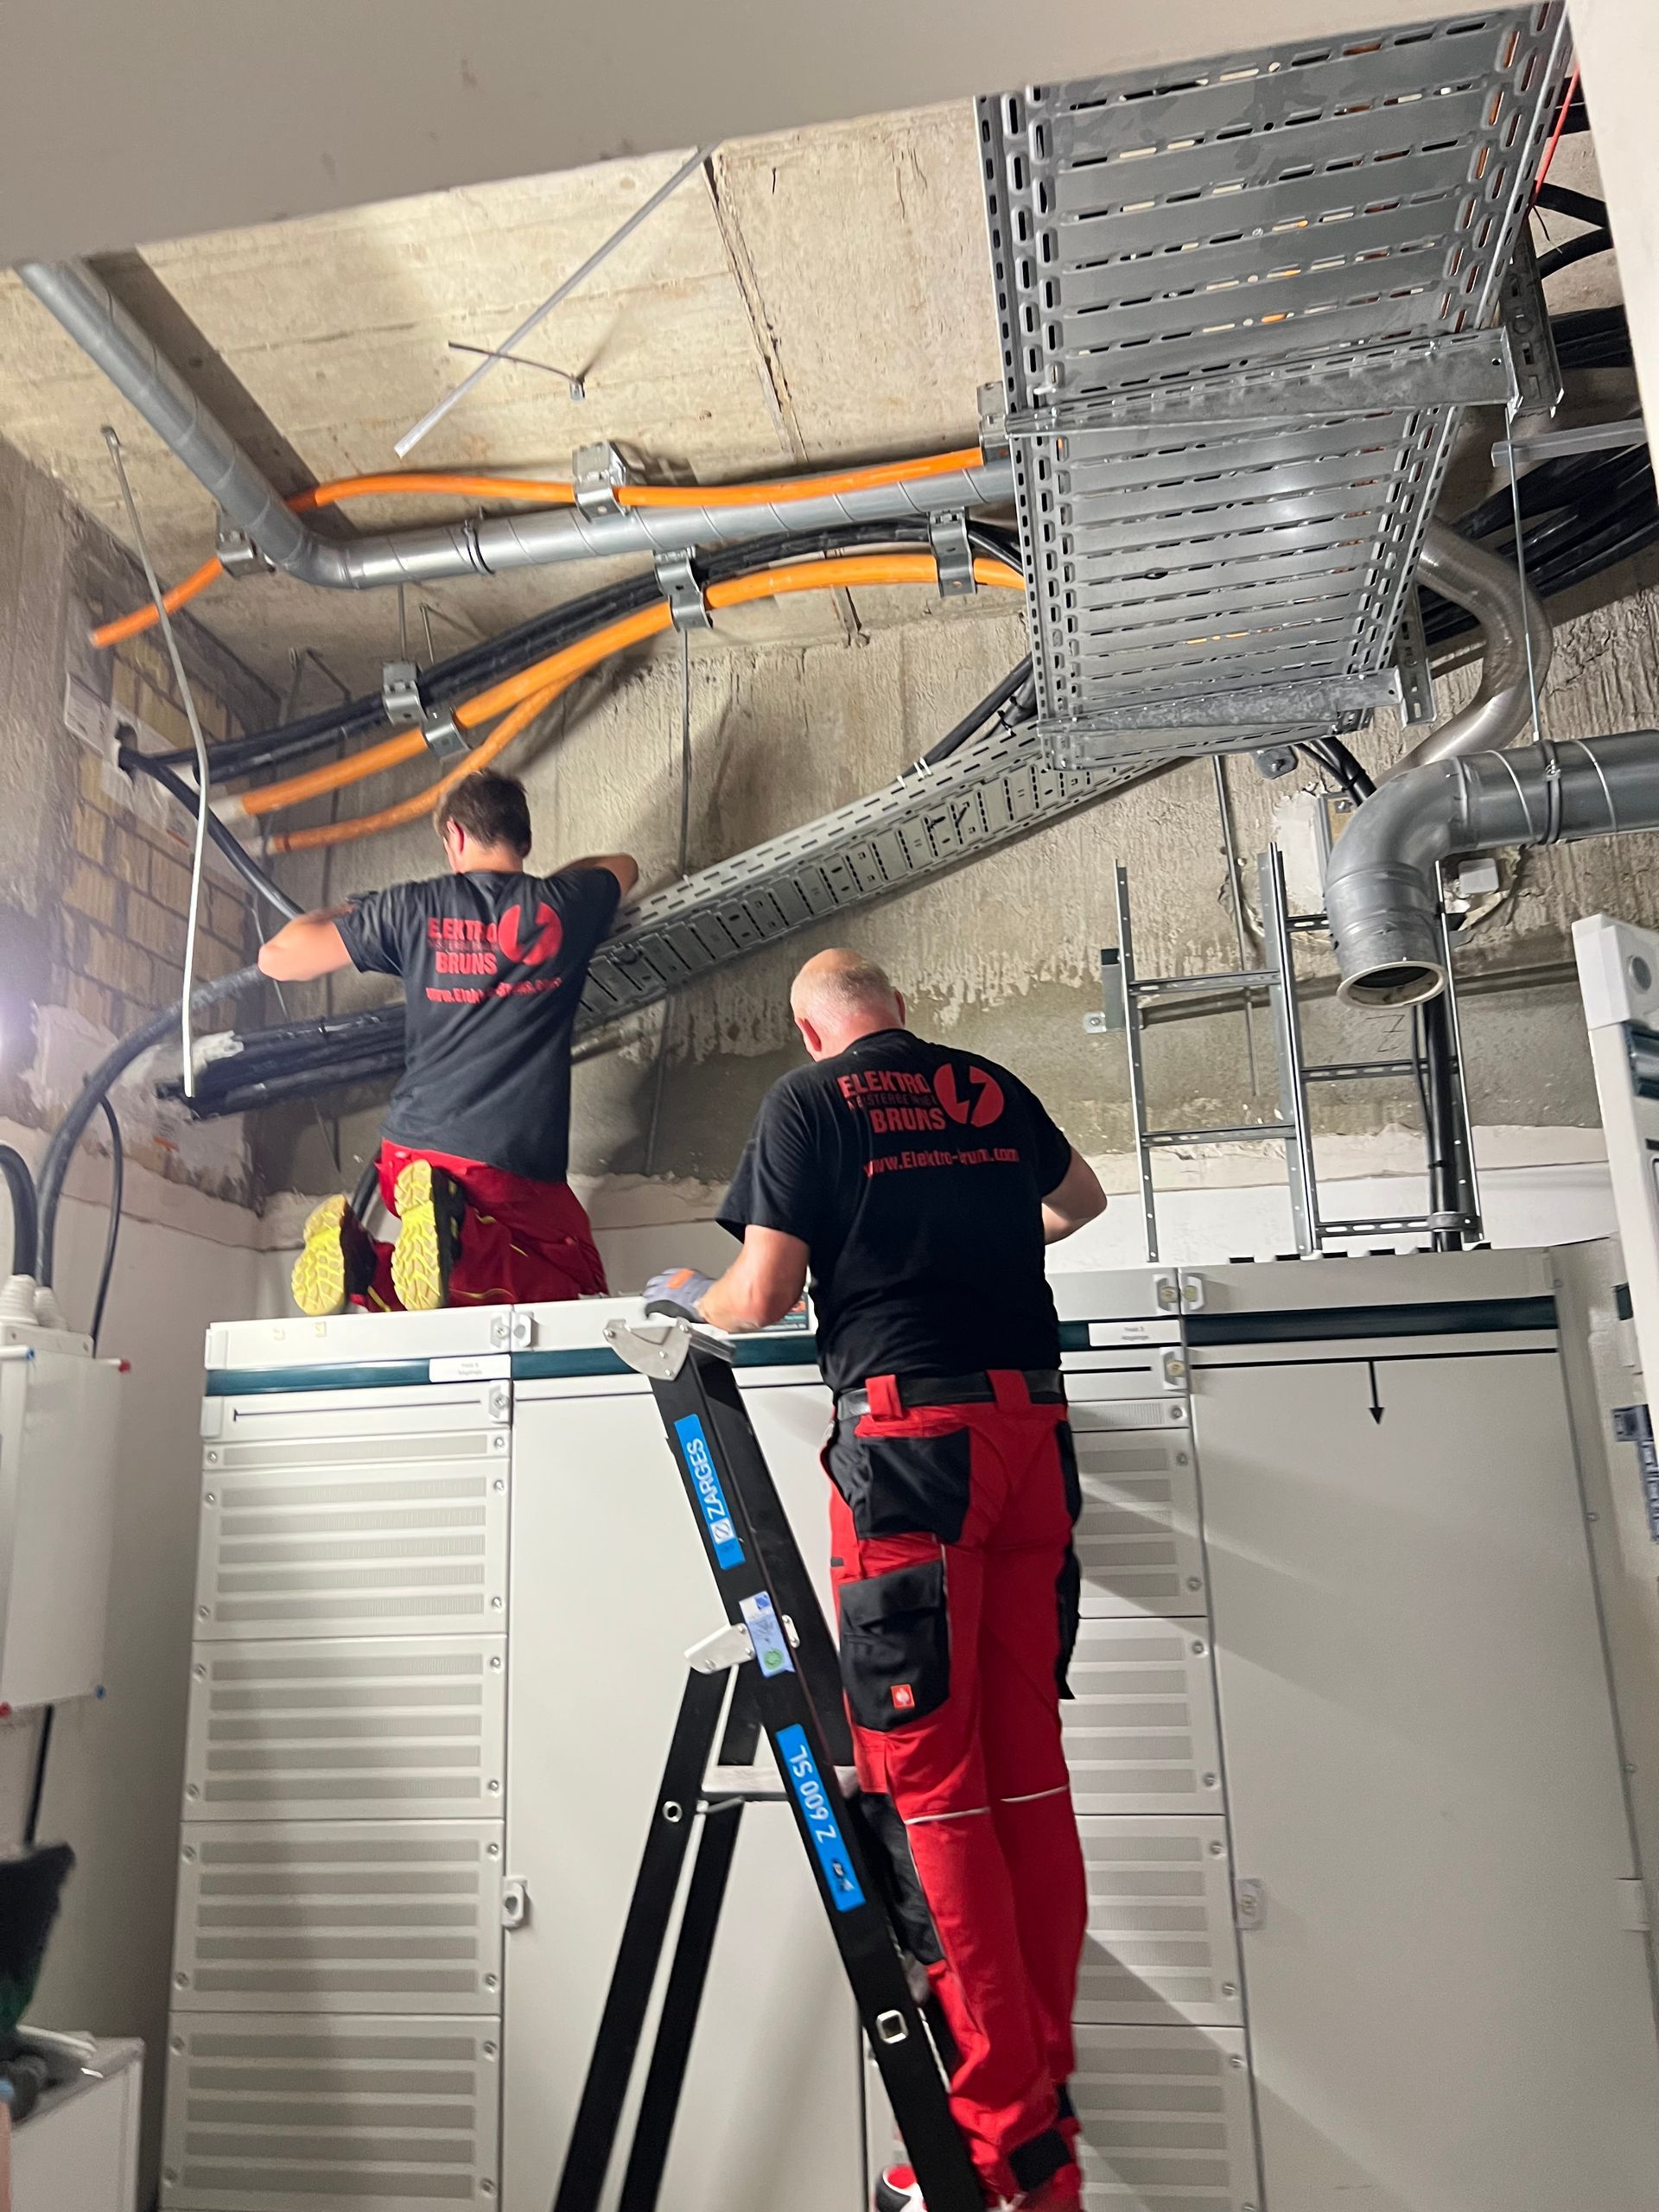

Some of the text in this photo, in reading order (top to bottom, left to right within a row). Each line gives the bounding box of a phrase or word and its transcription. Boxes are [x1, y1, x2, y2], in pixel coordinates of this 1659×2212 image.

[435, 951, 498, 976] BRUNS
[836, 1071, 931, 1099] ELEKTRO
[869, 1107, 946, 1134] BRUNS
[686, 1438, 726, 1521] ZARGES
[789, 1745, 837, 1844] Z 600 SL
